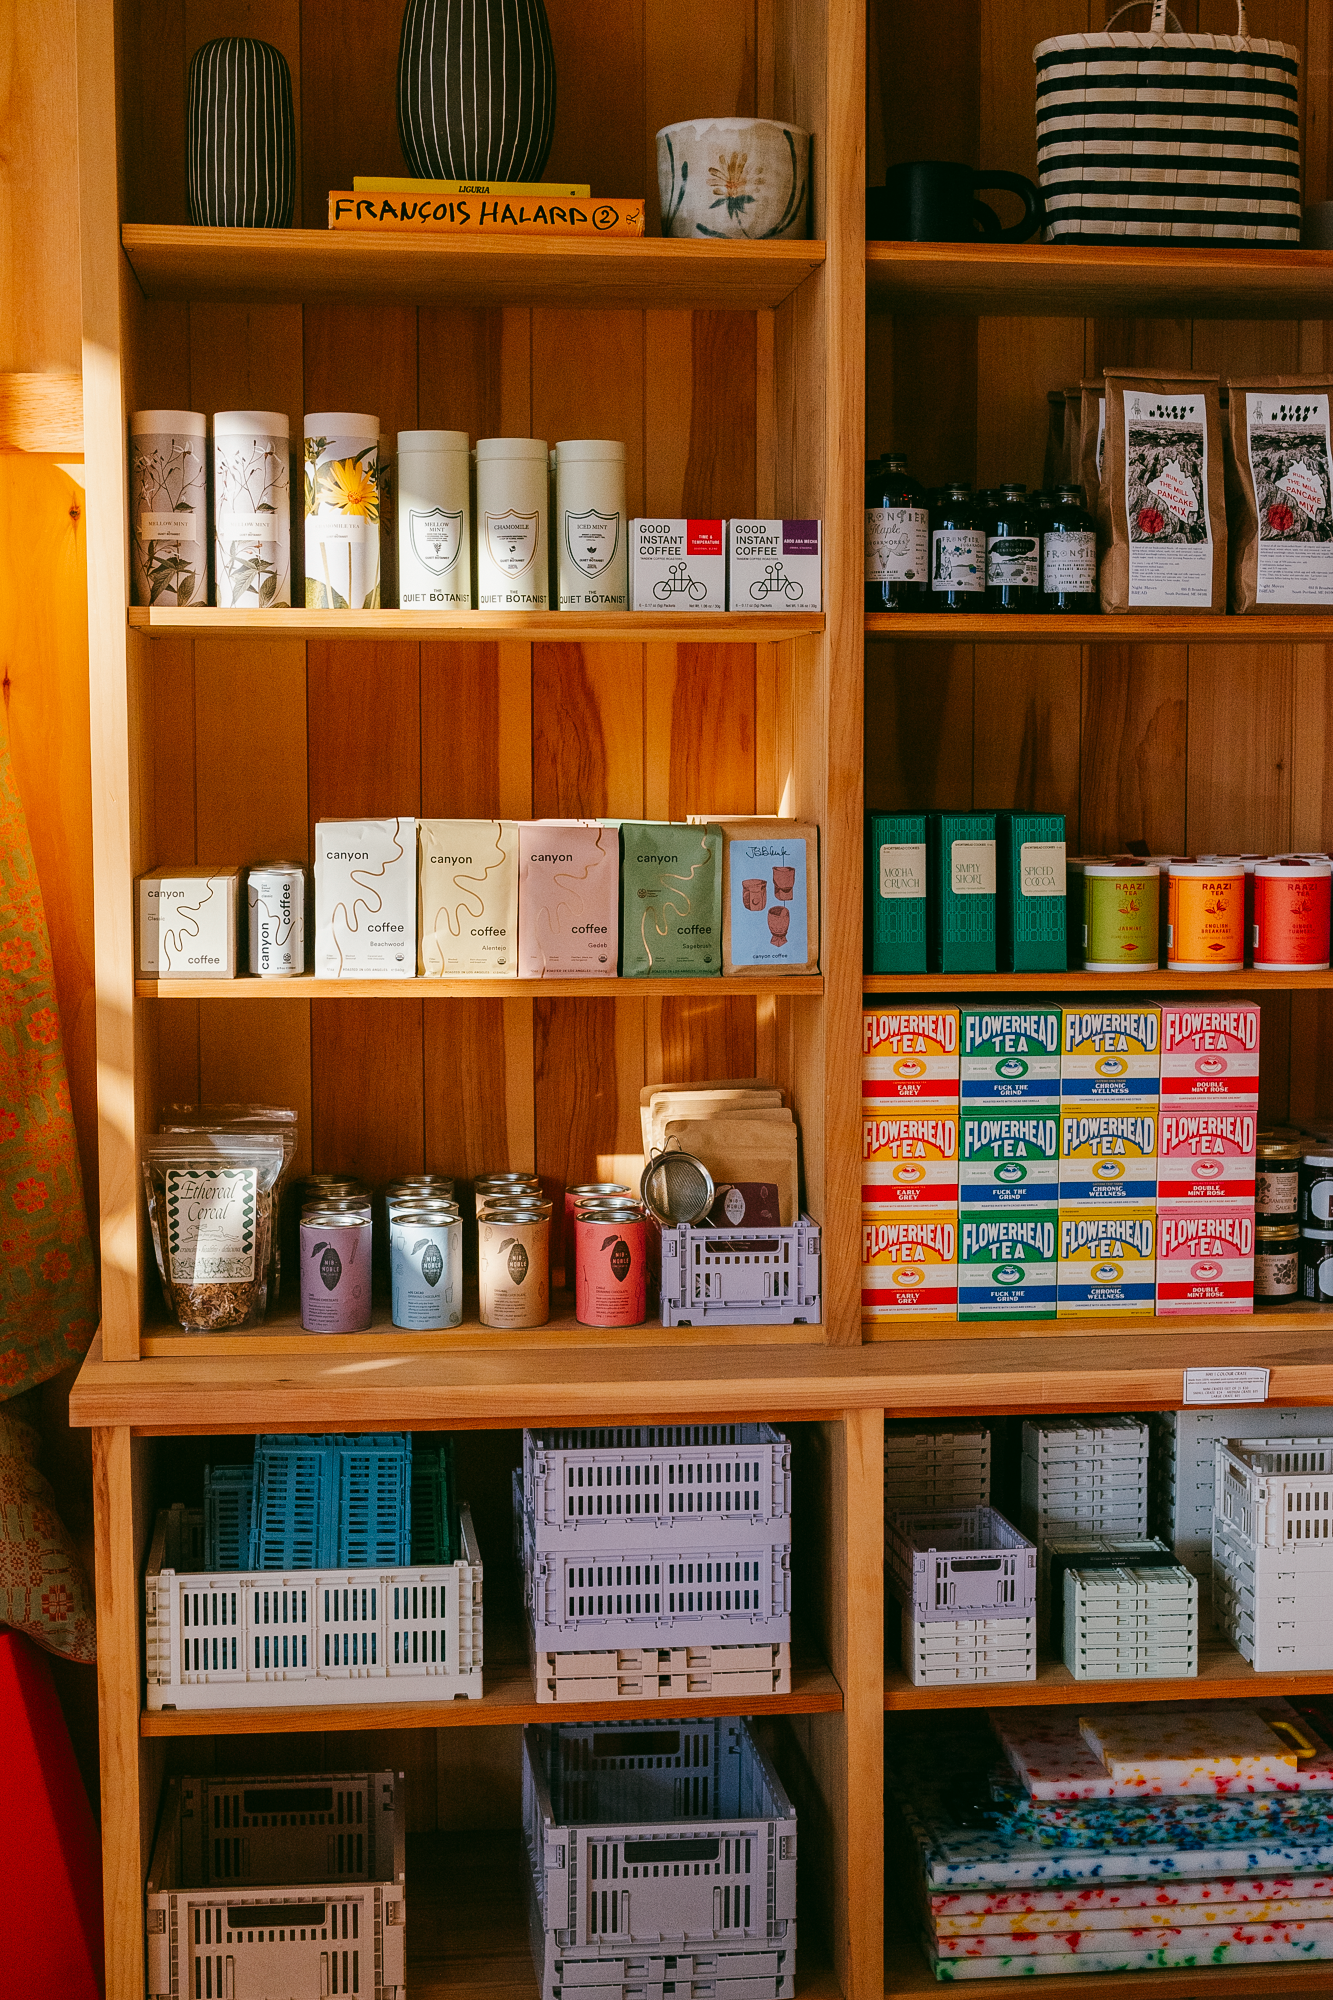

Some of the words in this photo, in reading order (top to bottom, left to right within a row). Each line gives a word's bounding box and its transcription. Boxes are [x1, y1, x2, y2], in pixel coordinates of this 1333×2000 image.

[459, 186, 490, 194] LIGURIA
[335, 199, 471, 225] FRANÇOIS
[479, 201, 588, 225] HALARD
[1165, 473, 1178, 483] RUN
[1292, 472, 1305, 480] RUN
[1160, 480, 1172, 490] THE
[1173, 486, 1189, 497] MILL
[1287, 478, 1300, 487] THE
[1302, 483, 1317, 493] MILL
[1157, 489, 1194, 508] PANCAKE
[1286, 486, 1321, 504] PANCAKE
[1170, 504, 1187, 518] MIX
[1299, 501, 1315, 514] MIX
[640, 525, 670, 533] GOOD
[736, 525, 766, 534] GOOD
[640, 536, 684, 544] INSTANT
[736, 536, 779, 544] INSTANT
[640, 546, 681, 555] COFFEE
[735, 547, 777, 555] COFFEE
[403, 594, 426, 602] QUIET
[430, 594, 469, 602] BOTANIST
[481, 595, 502, 603] QUIET
[506, 595, 546, 603] BOTANIST
[560, 595, 581, 604] QUIET
[584, 595, 625, 603] BOTANIST
[326, 851, 369, 861] canyon
[430, 856, 472, 866] canyon
[531, 854, 573, 864] canyon
[637, 855, 678, 865] canyon
[884, 867, 913, 877] MOCHA
[955, 864, 980, 872] SIMPLY
[1025, 866, 1053, 875] SPICED
[884, 879, 919, 889] CRUNCH
[955, 874, 982, 884] SHORT
[1025, 877, 1055, 886] COCOA
[148, 890, 185, 899] canyon
[280, 883, 290, 925] coffee
[367, 922, 404, 932] coffee
[470, 927, 506, 936] coffee
[571, 924, 607, 933] coffee
[677, 925, 711, 934] coffee
[262, 923, 272, 969] canyon
[188, 955, 220, 964] coffee
[864, 1015, 956, 1053] FLOWERHEAD
[966, 1015, 1057, 1053] FLOWERHEAD
[1065, 1014, 1157, 1052] FLOWERHEAD
[1166, 1012, 1257, 1050] FLOWERHEAD
[890, 1035, 926, 1053] TEA
[991, 1034, 1029, 1053] TEA
[1091, 1033, 1129, 1052] TEA
[1191, 1031, 1228, 1050] TEA
[863, 1120, 955, 1158] FLOWERHEAD
[965, 1120, 1056, 1158] FLOWERHEAD
[1063, 1117, 1154, 1155] FLOWERHEAD
[1162, 1116, 1253, 1155] FLOWERHEAD
[889, 1140, 926, 1158] TEA
[990, 1139, 1027, 1158] TEA
[1088, 1137, 1126, 1155] TEA
[1188, 1136, 1225, 1154] TEA
[180, 1179, 243, 1199] Ethereal
[188, 1200, 235, 1221] Cereal
[862, 1224, 954, 1262] FLOWERHEAD
[963, 1222, 1054, 1260] FLOWERHEAD
[1061, 1219, 1153, 1258] FLOWERHEAD
[1162, 1219, 1251, 1257] FLOWERHEAD
[888, 1244, 925, 1262] TEA
[988, 1242, 1025, 1260] TEA
[1087, 1239, 1124, 1258] TEA
[1187, 1238, 1223, 1256] TEA
